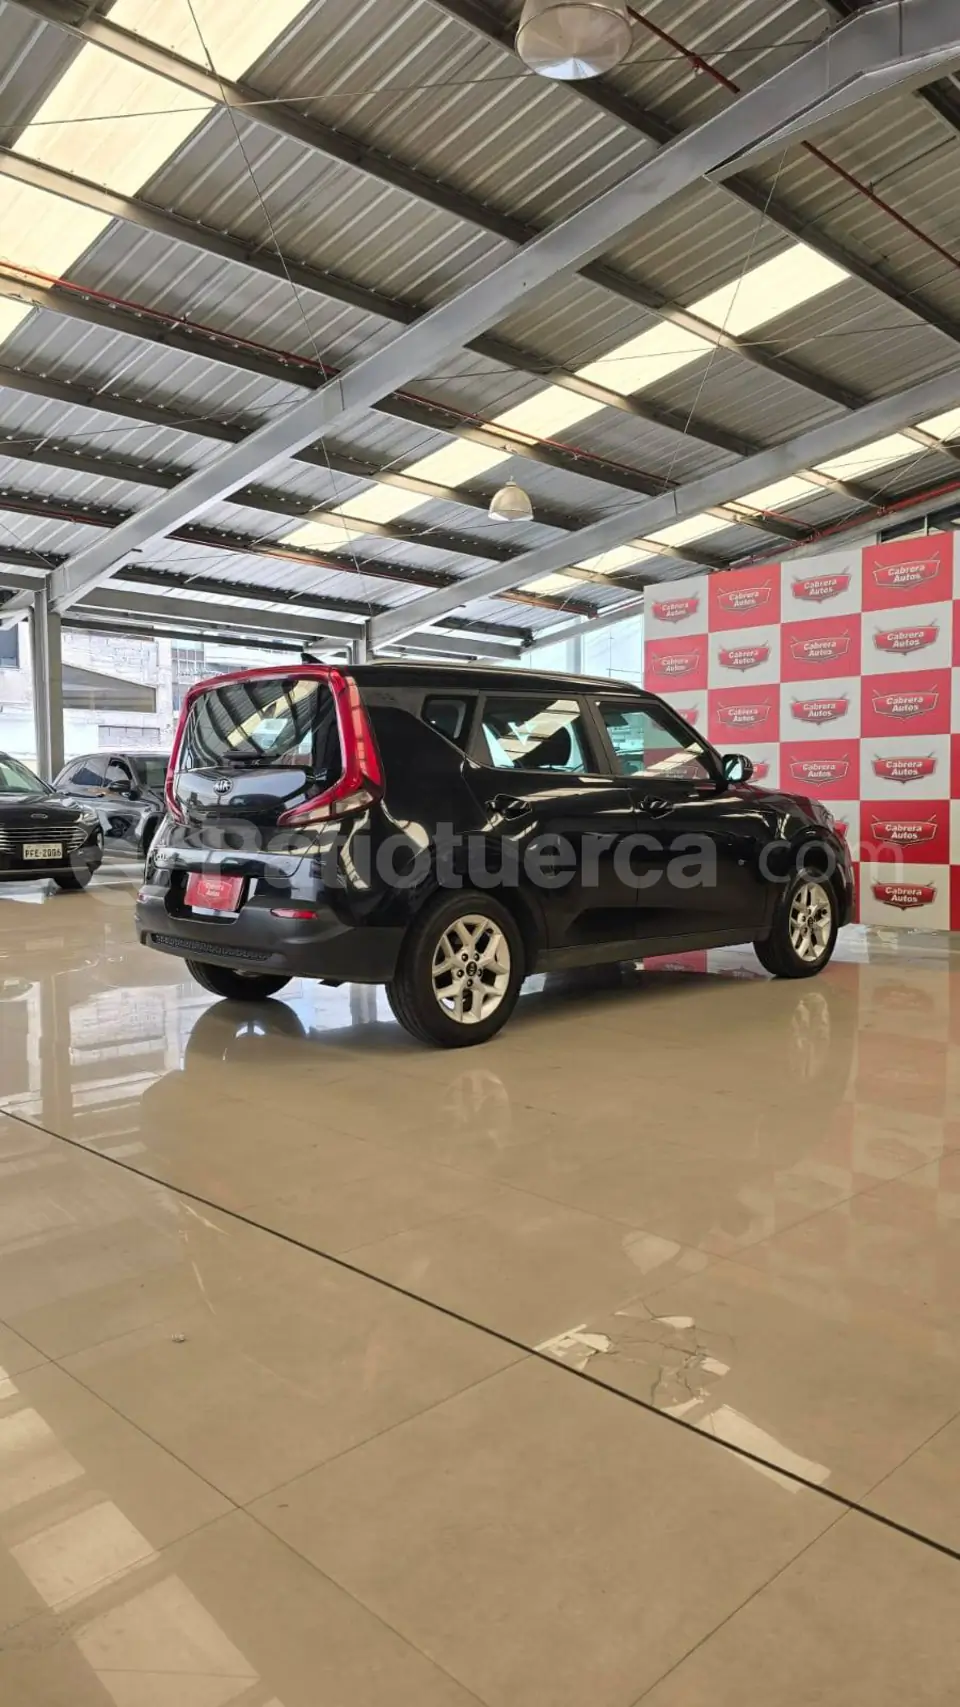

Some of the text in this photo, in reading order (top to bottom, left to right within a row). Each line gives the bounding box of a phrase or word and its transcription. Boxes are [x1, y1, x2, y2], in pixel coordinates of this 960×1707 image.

[888, 564, 925, 576] Cabrera
[893, 573, 921, 583] Autos
[804, 578, 837, 589] Cabrera
[728, 590, 759, 601] Cabrera
[809, 587, 833, 596] Autos
[661, 602, 689, 611] Cabrera
[733, 598, 756, 607] Autos
[887, 630, 925, 641] Cabrera
[803, 641, 837, 651] Cabrera
[892, 638, 920, 648] Autos
[728, 650, 759, 659] Cabrera
[808, 648, 833, 657] Autos
[733, 657, 755, 665] Autos
[886, 695, 924, 705] Cabrera
[803, 702, 836, 711] Cabrera
[891, 703, 919, 712] Autos
[728, 707, 759, 716] Cabrera
[808, 709, 832, 718] Autos
[733, 714, 755, 722] Autos
[802, 763, 836, 771] Cabrera
[886, 760, 923, 769] Cabrera
[807, 769, 832, 777] Autos
[891, 767, 918, 776] Autos
[885, 823, 923, 833] Cabrera
[890, 831, 918, 840] Autos
[885, 886, 922, 896] Cabrera
[890, 894, 918, 903] Autos
